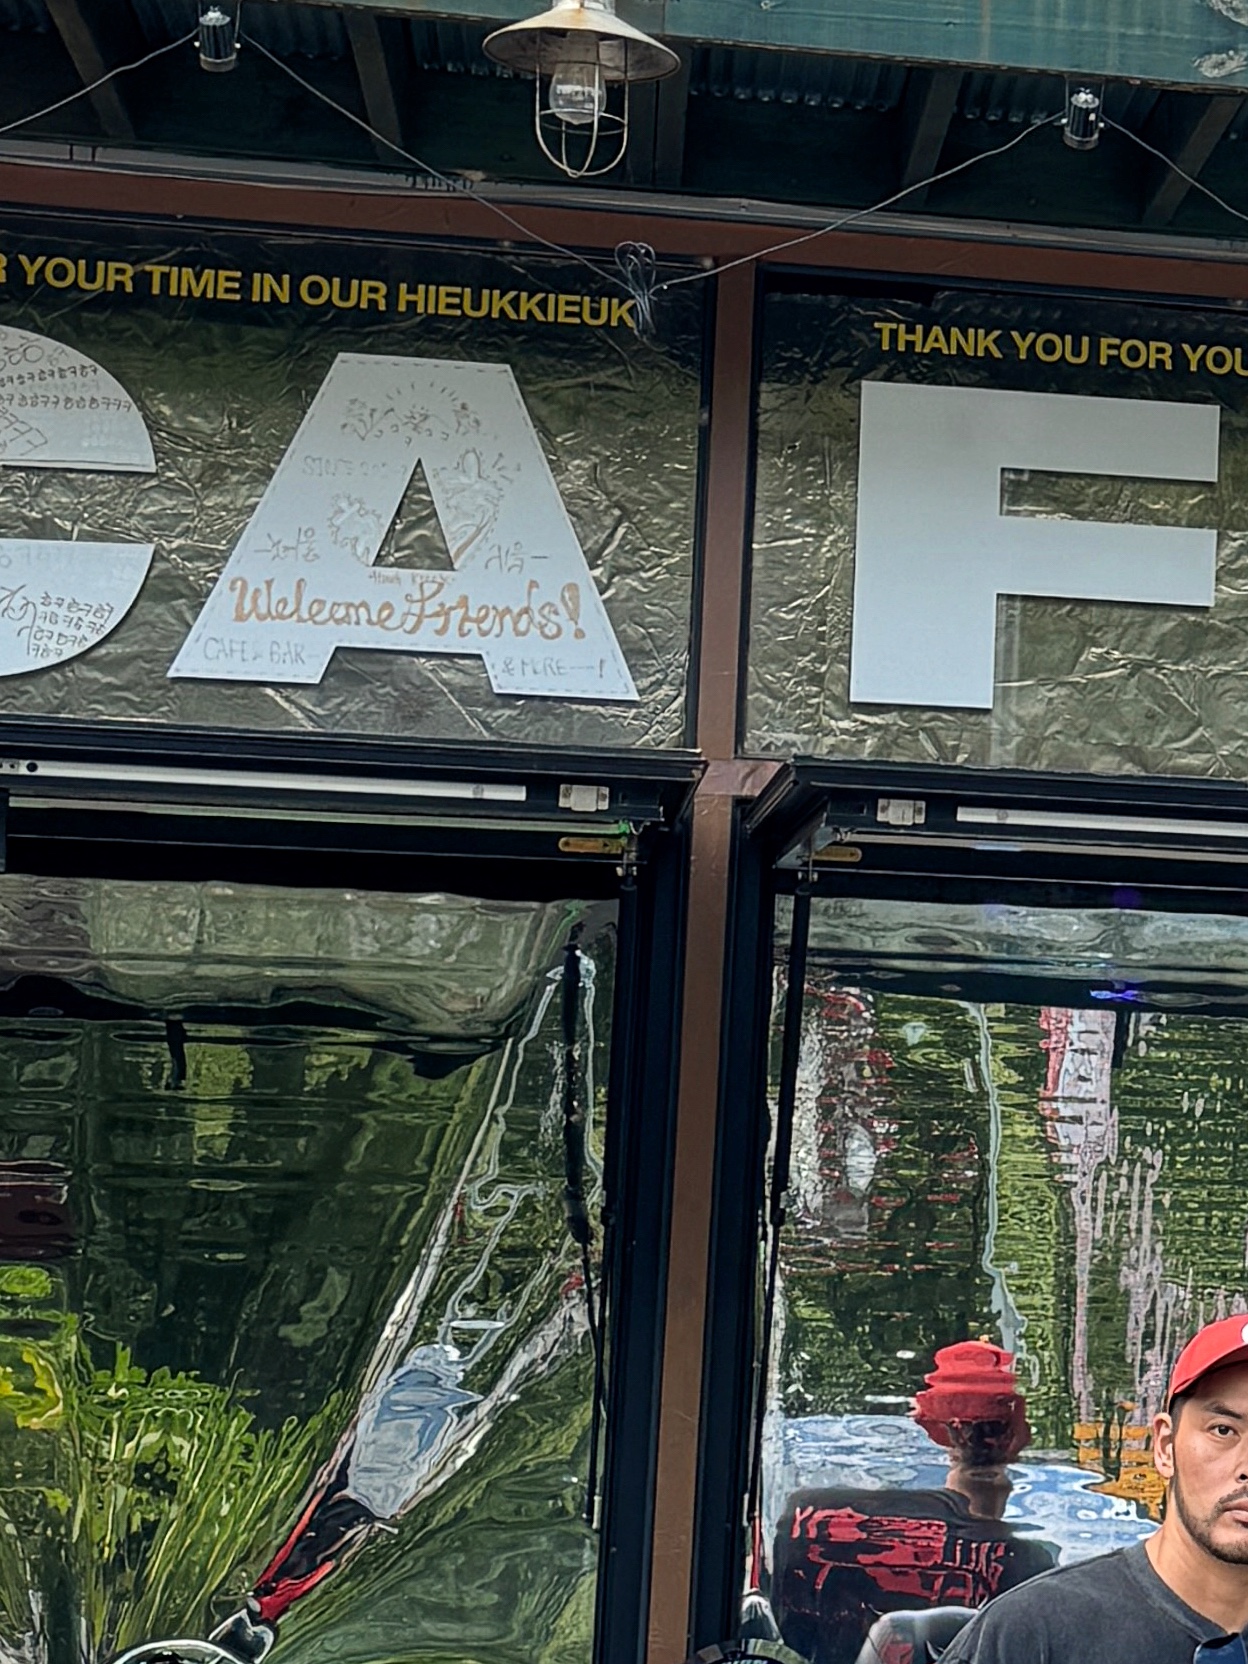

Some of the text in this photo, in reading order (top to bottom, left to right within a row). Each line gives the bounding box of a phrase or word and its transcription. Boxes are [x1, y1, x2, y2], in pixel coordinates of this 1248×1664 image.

[17, 253, 135, 293] YOUR
[143, 264, 243, 300] TIME
[250, 272, 291, 304] IN
[299, 274, 387, 312] OUR
[397, 282, 639, 328] HIEUKKIEUK
[873, 321, 1004, 359] THANK
[1010, 330, 1090, 364] YOU
[1099, 337, 1172, 371] FOR
[229, 576, 404, 631] Welcome
